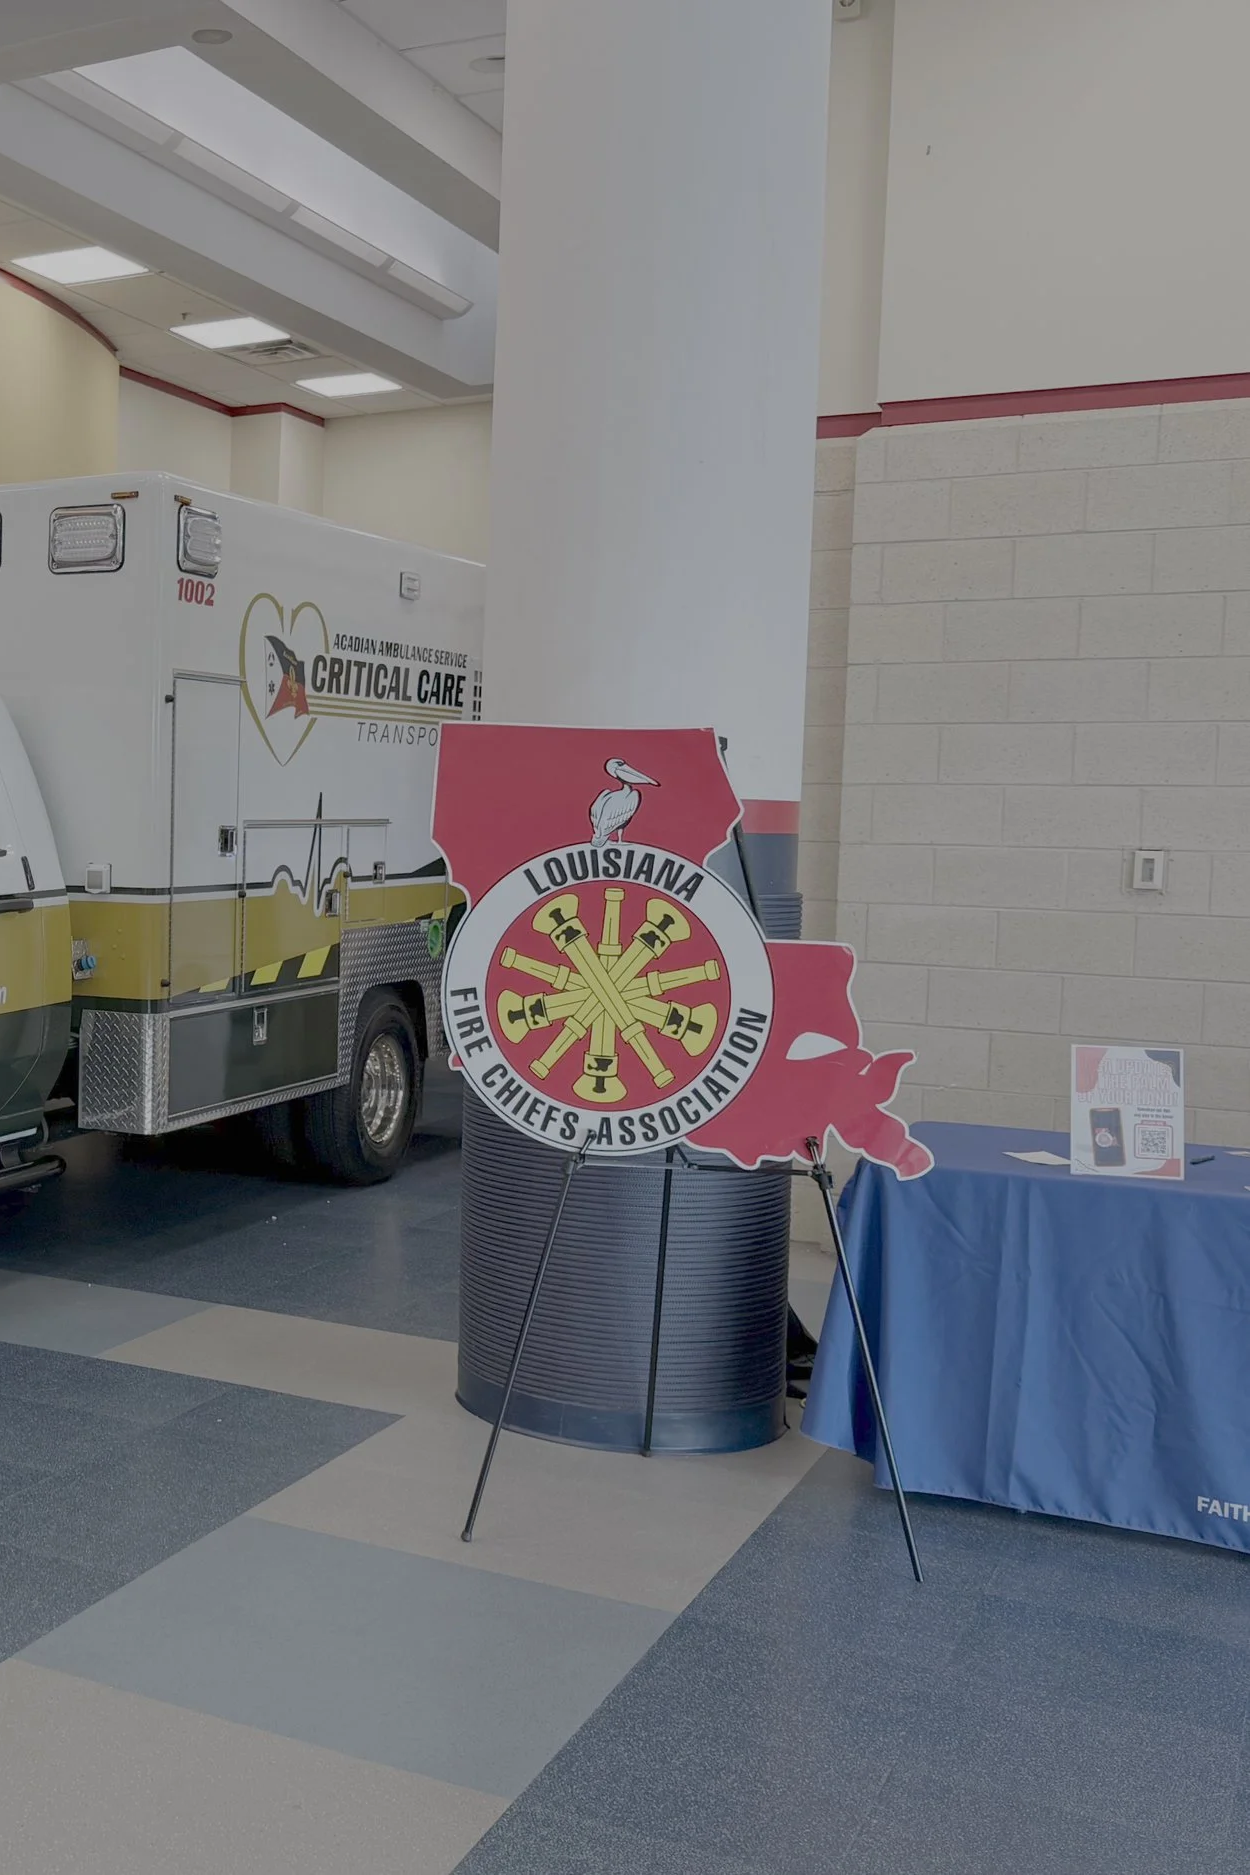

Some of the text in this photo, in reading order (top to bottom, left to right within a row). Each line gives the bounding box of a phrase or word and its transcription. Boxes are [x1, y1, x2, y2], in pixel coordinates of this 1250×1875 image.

[177, 577, 215, 606] 1002
[333, 633, 468, 668] ACADIAN AMBULANCE SERVICE
[311, 654, 466, 707] CRITICAL CARE
[357, 722, 438, 746] TRANSPO
[523, 847, 704, 903] LOUISIANA
[450, 987, 768, 1147] FIRE CHIEFS ASSOCIATION
